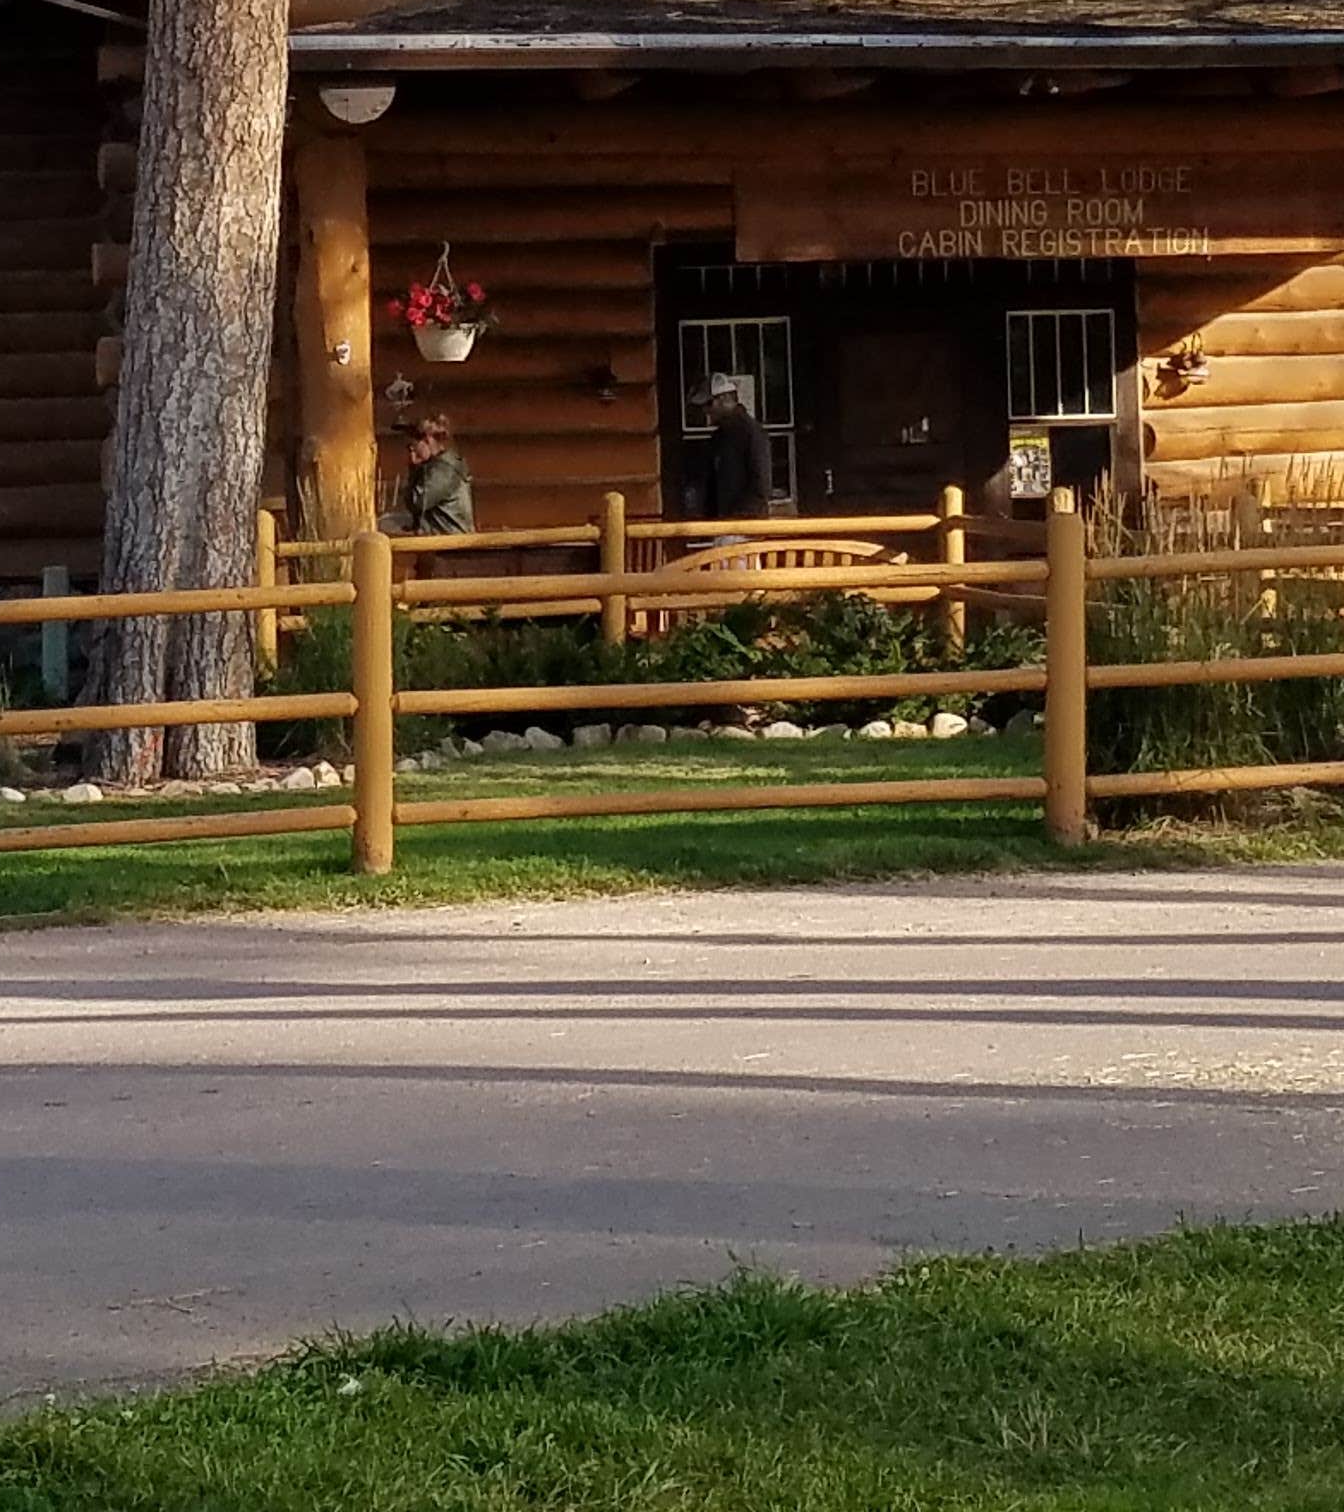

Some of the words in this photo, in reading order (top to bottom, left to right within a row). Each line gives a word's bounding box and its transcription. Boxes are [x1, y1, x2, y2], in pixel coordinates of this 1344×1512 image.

[910, 168, 986, 197] BLUE
[1007, 167, 1081, 196] BELL
[1099, 166, 1194, 194] LODGE
[960, 200, 1049, 227] DINING
[1067, 198, 1144, 226] ROOM
[899, 230, 984, 257] CABIN
[1002, 228, 1209, 257] REGISTRATION
